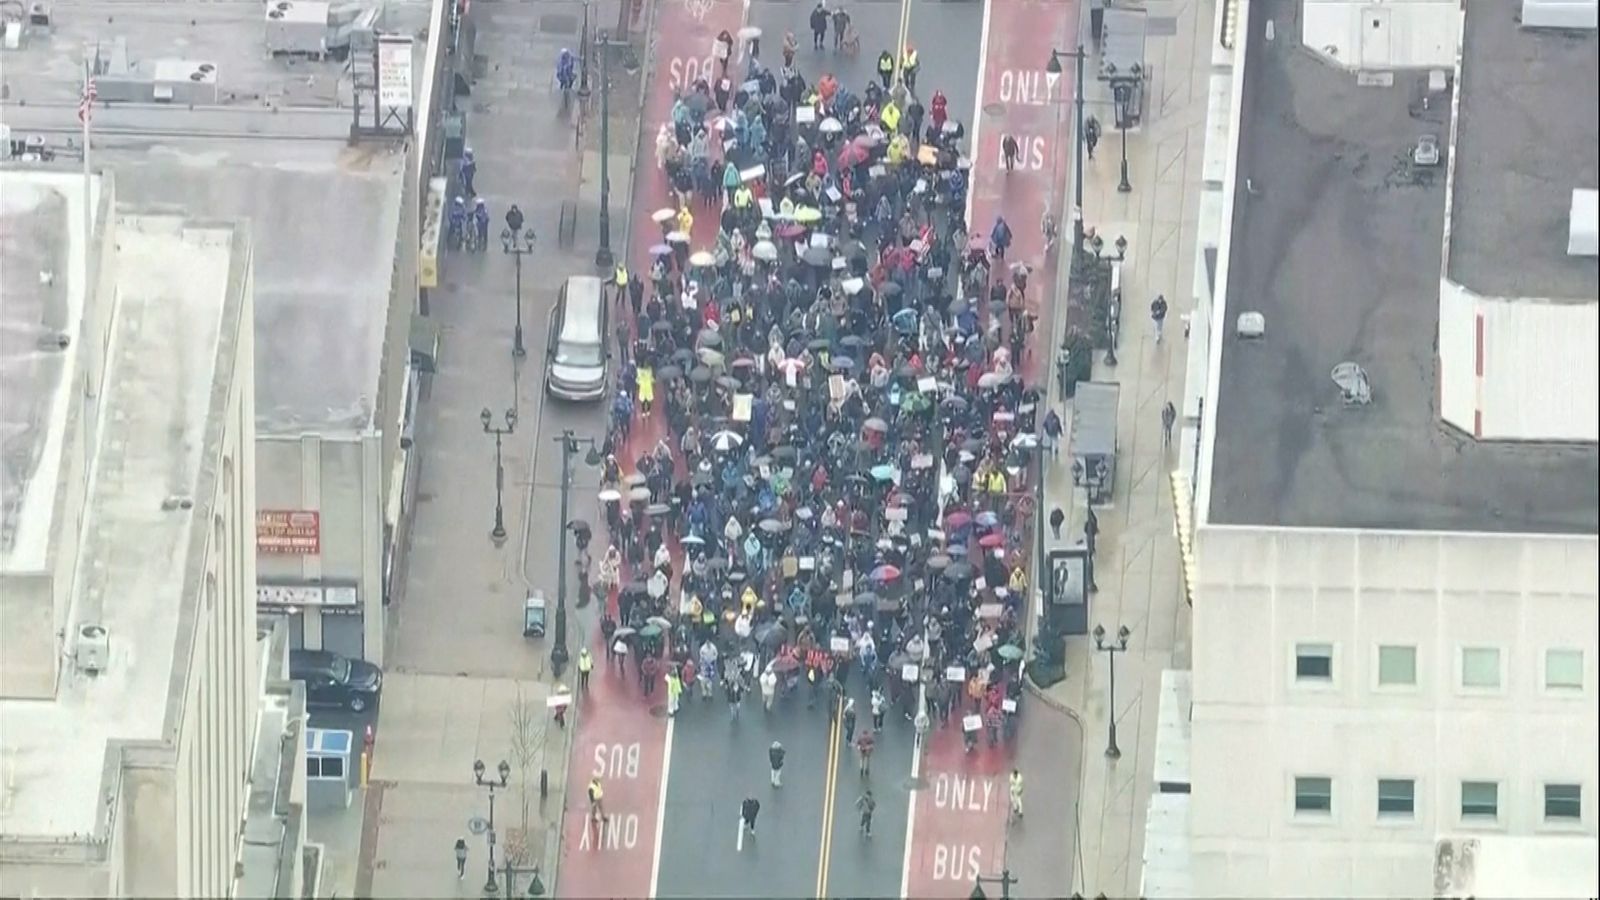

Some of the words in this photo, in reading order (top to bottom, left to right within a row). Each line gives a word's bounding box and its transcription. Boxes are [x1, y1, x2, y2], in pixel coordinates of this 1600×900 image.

[1000, 69, 1060, 105] ONLY
[592, 742, 640, 779] BUS
[935, 772, 993, 812] ONLY
[579, 813, 638, 850] ONLY
[933, 844, 981, 881] BUS
